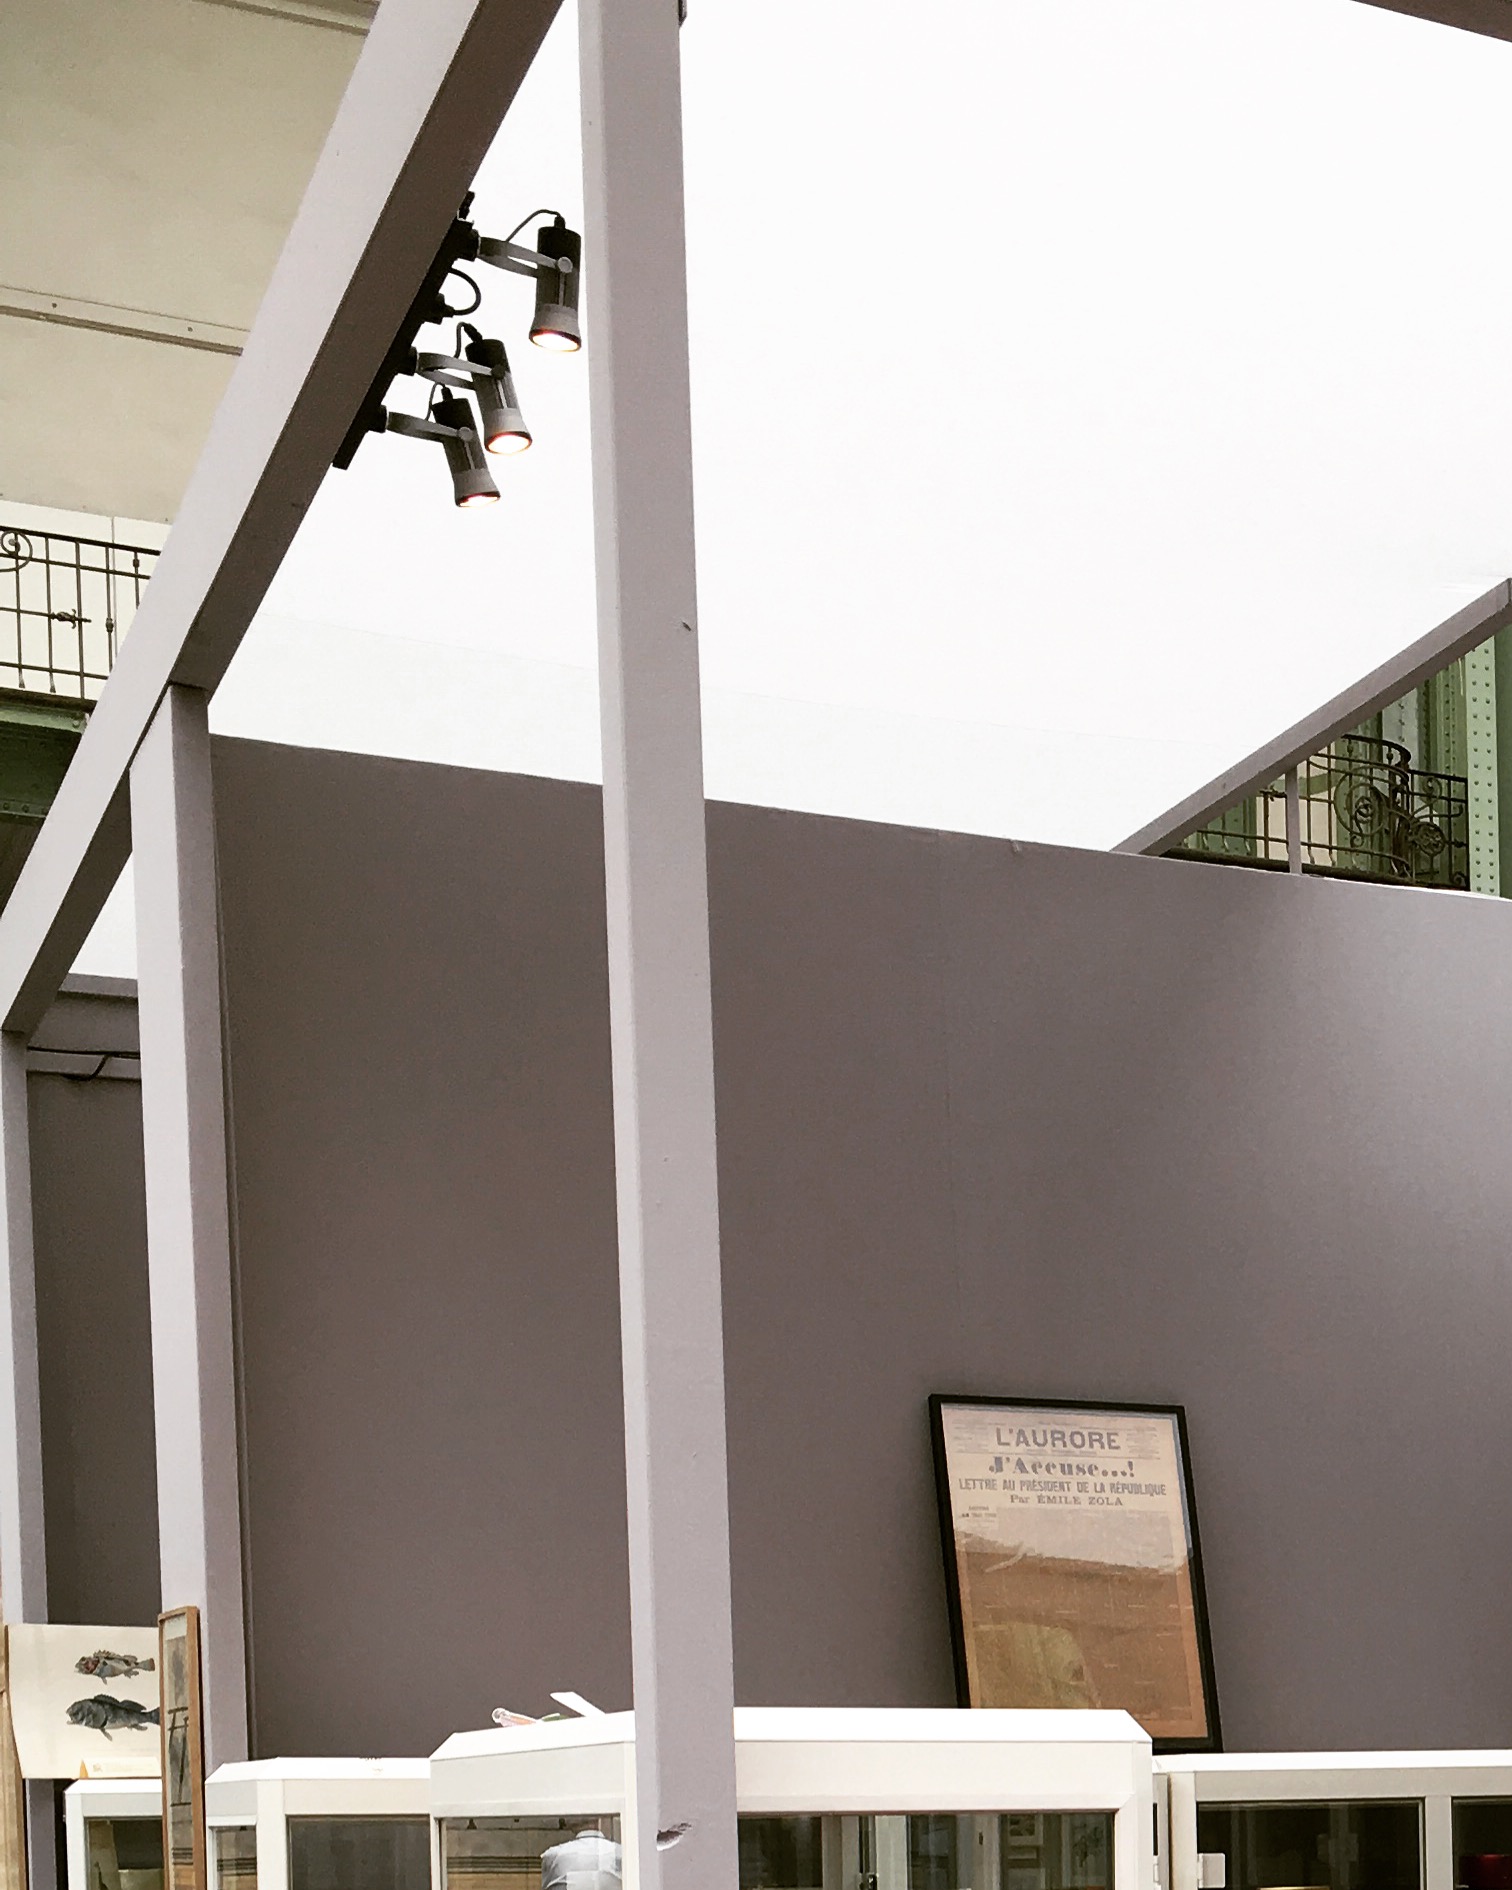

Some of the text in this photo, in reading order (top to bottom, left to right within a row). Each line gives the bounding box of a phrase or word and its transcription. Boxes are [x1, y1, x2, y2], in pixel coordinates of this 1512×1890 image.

[996, 1426, 1121, 1450] L'AURORE
[988, 1456, 1136, 1478] J'Accuse...!
[958, 1478, 998, 1491] LETTRE
[1002, 1479, 1016, 1492] AU
[1077, 1480, 1090, 1494] DE
[1094, 1481, 1106, 1494] LA
[1109, 1481, 1167, 1497] RÉPUBLIQUE
[1010, 1494, 1124, 1506] Par ÉMILE ZOLA
